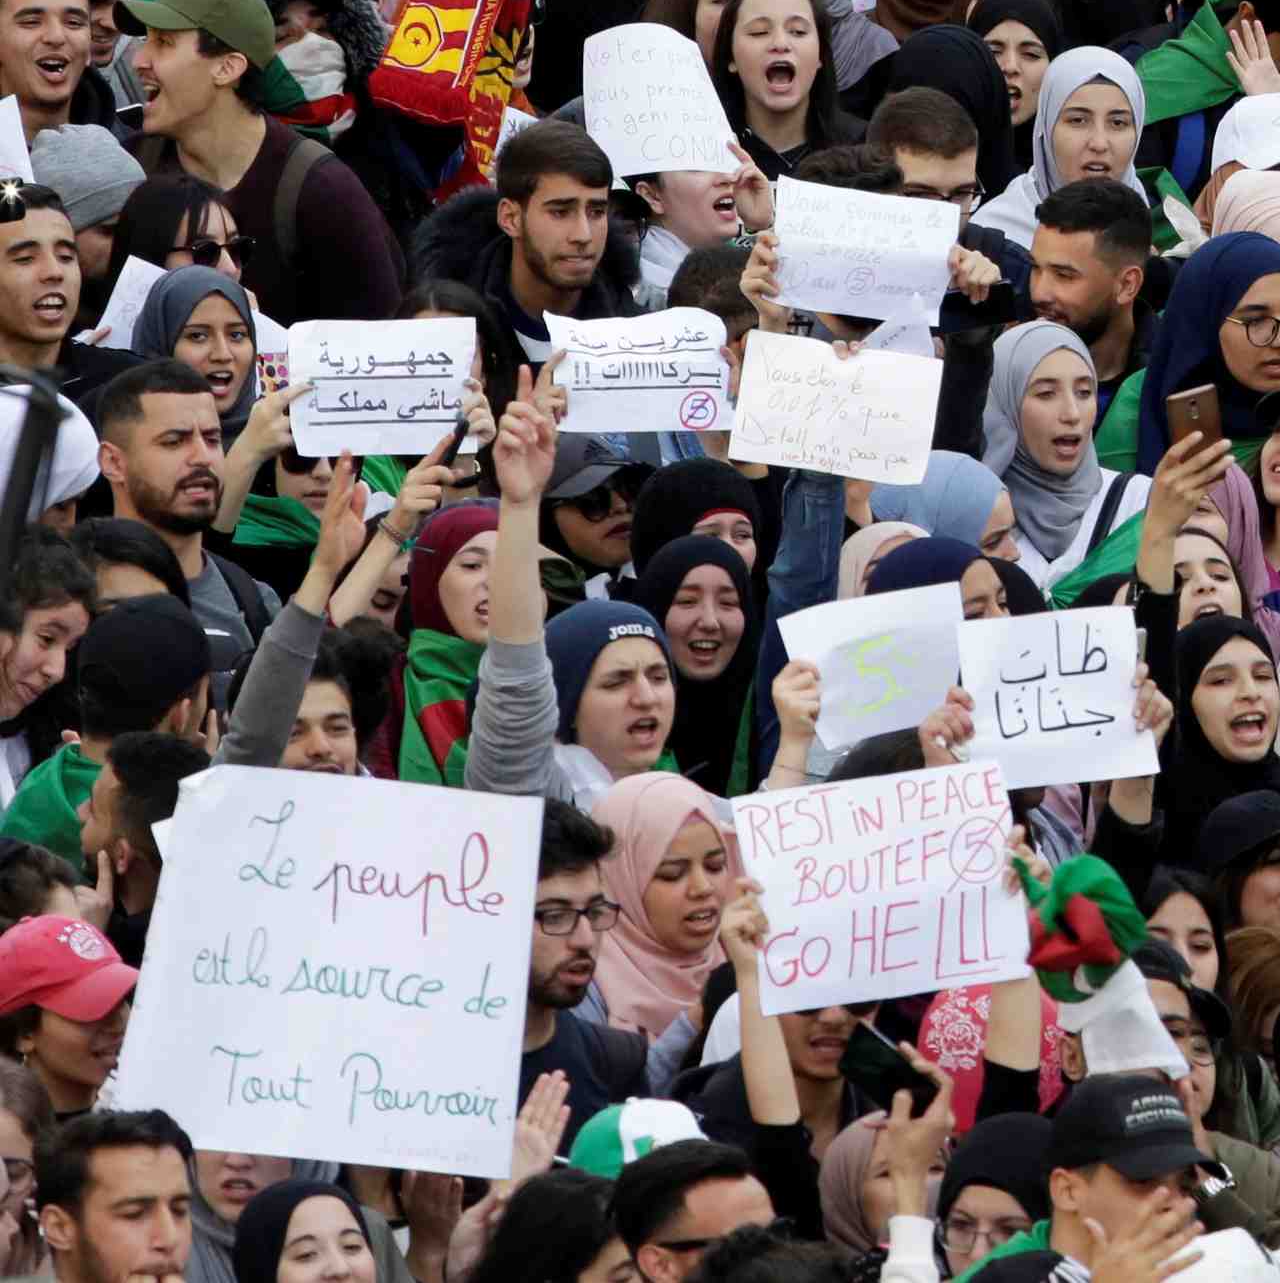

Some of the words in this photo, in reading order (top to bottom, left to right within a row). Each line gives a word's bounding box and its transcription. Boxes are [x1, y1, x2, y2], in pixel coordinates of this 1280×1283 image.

[738, 786, 841, 859] REST
[896, 767, 1006, 824] PEACE
[239, 799, 297, 890] Le
[313, 831, 506, 940] peuple
[280, 956, 445, 1009] source
[464, 961, 508, 1021] de
[764, 926, 832, 988] GO
[210, 1044, 313, 1110] Tout
